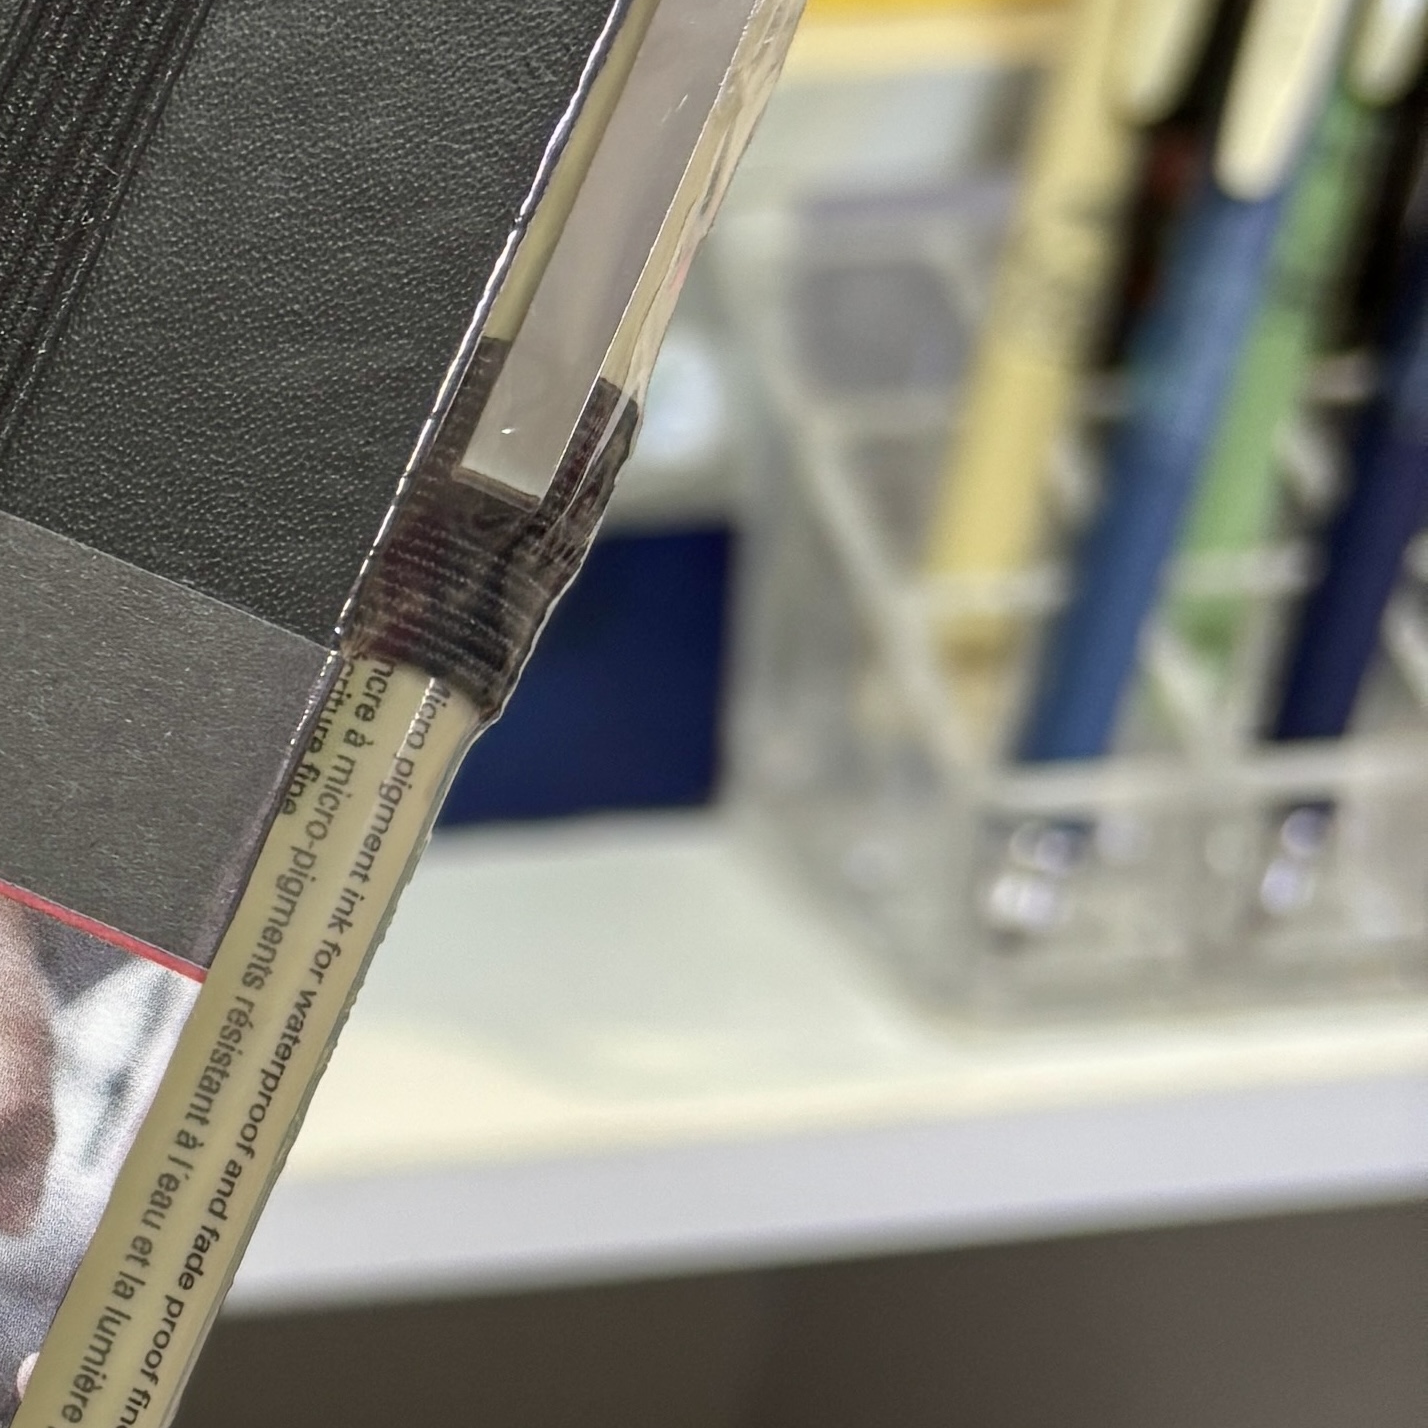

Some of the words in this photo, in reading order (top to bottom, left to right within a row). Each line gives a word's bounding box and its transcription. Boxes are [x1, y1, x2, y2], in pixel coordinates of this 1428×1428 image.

[354, 655, 396, 723] ncre
[343, 728, 375, 749] à
[347, 753, 416, 884] pigment
[241, 754, 357, 991] micro-pigments
[327, 887, 366, 935] ink
[308, 938, 342, 985] for
[185, 995, 255, 1127] résistant
[235, 988, 318, 1160] waterproof
[175, 1128, 205, 1151] à
[207, 1158, 243, 1221] and
[125, 1234, 155, 1269] et
[177, 1224, 221, 1291] fade
[112, 1271, 147, 1301] la
[60, 1305, 132, 1424] lumière
[139, 1293, 186, 1387] proof
